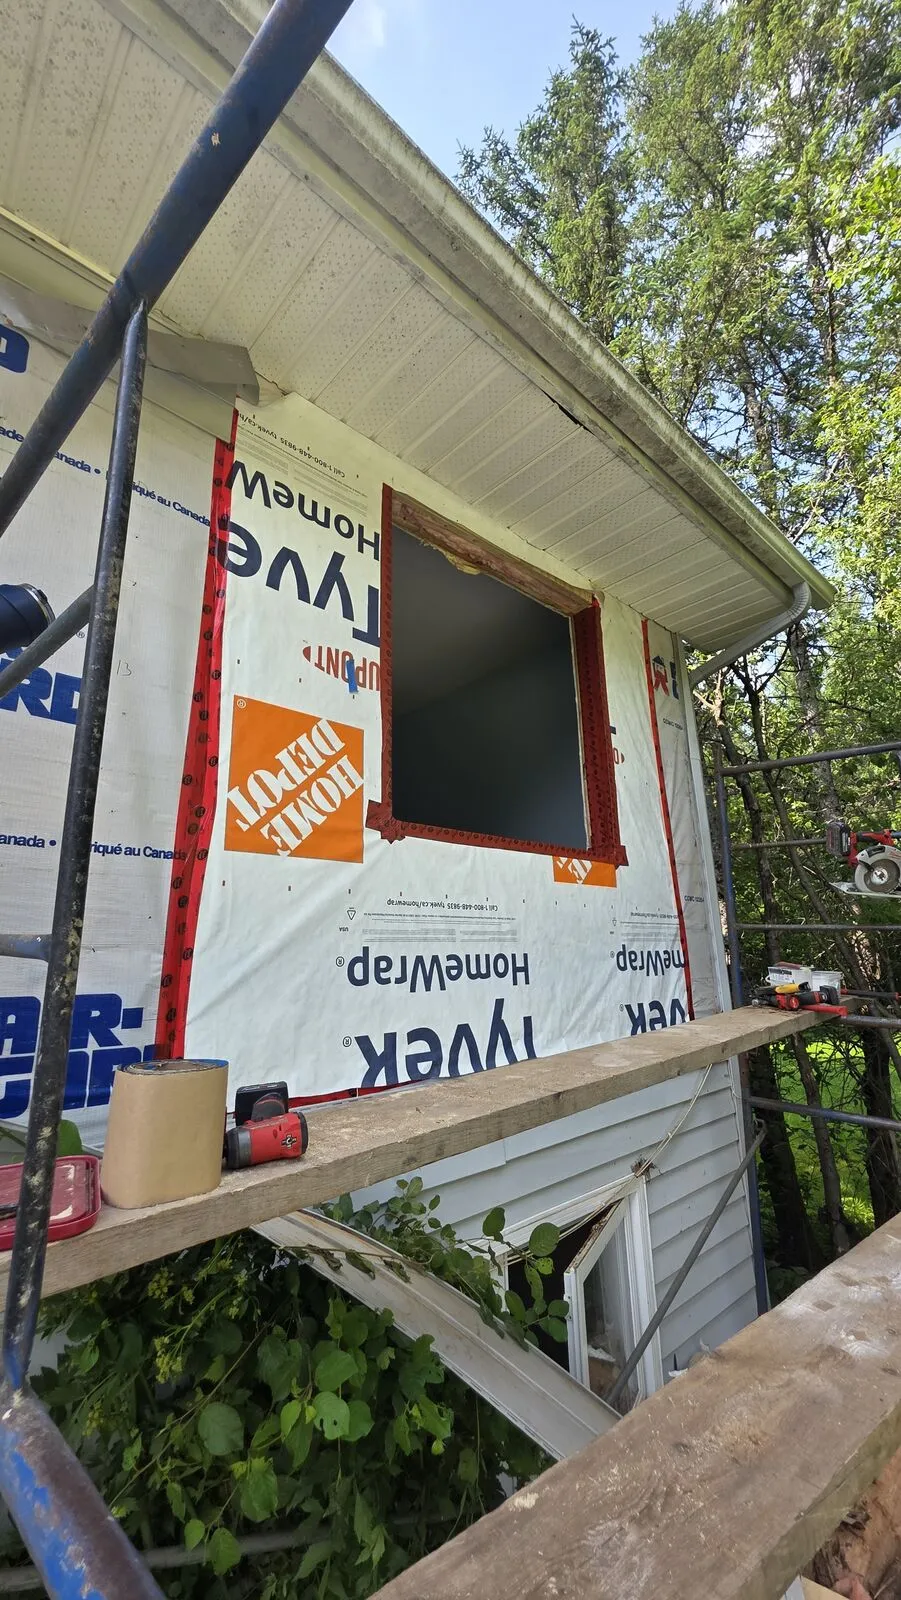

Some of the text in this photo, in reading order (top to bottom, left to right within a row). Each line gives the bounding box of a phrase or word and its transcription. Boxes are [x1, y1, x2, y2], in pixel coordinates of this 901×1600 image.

[0, 426, 24, 443] ade
[54, 451, 91, 473] anada
[157, 495, 171, 508] au
[172, 501, 211, 527] Canada
[225, 460, 380, 562] HomeW
[216, 517, 381, 648] Tyve
[314, 645, 380, 692] UPONT
[227, 718, 346, 832] DEPOT
[260, 754, 364, 857] HOME
[0, 833, 45, 849] anada
[91, 841, 122, 856] riqué
[124, 845, 140, 857] au
[387, 898, 445, 909] tyvek.ca/homewrap
[347, 946, 530, 993] HomeWrap
[616, 943, 686, 976] meWrap
[625, 998, 687, 1036] vek
